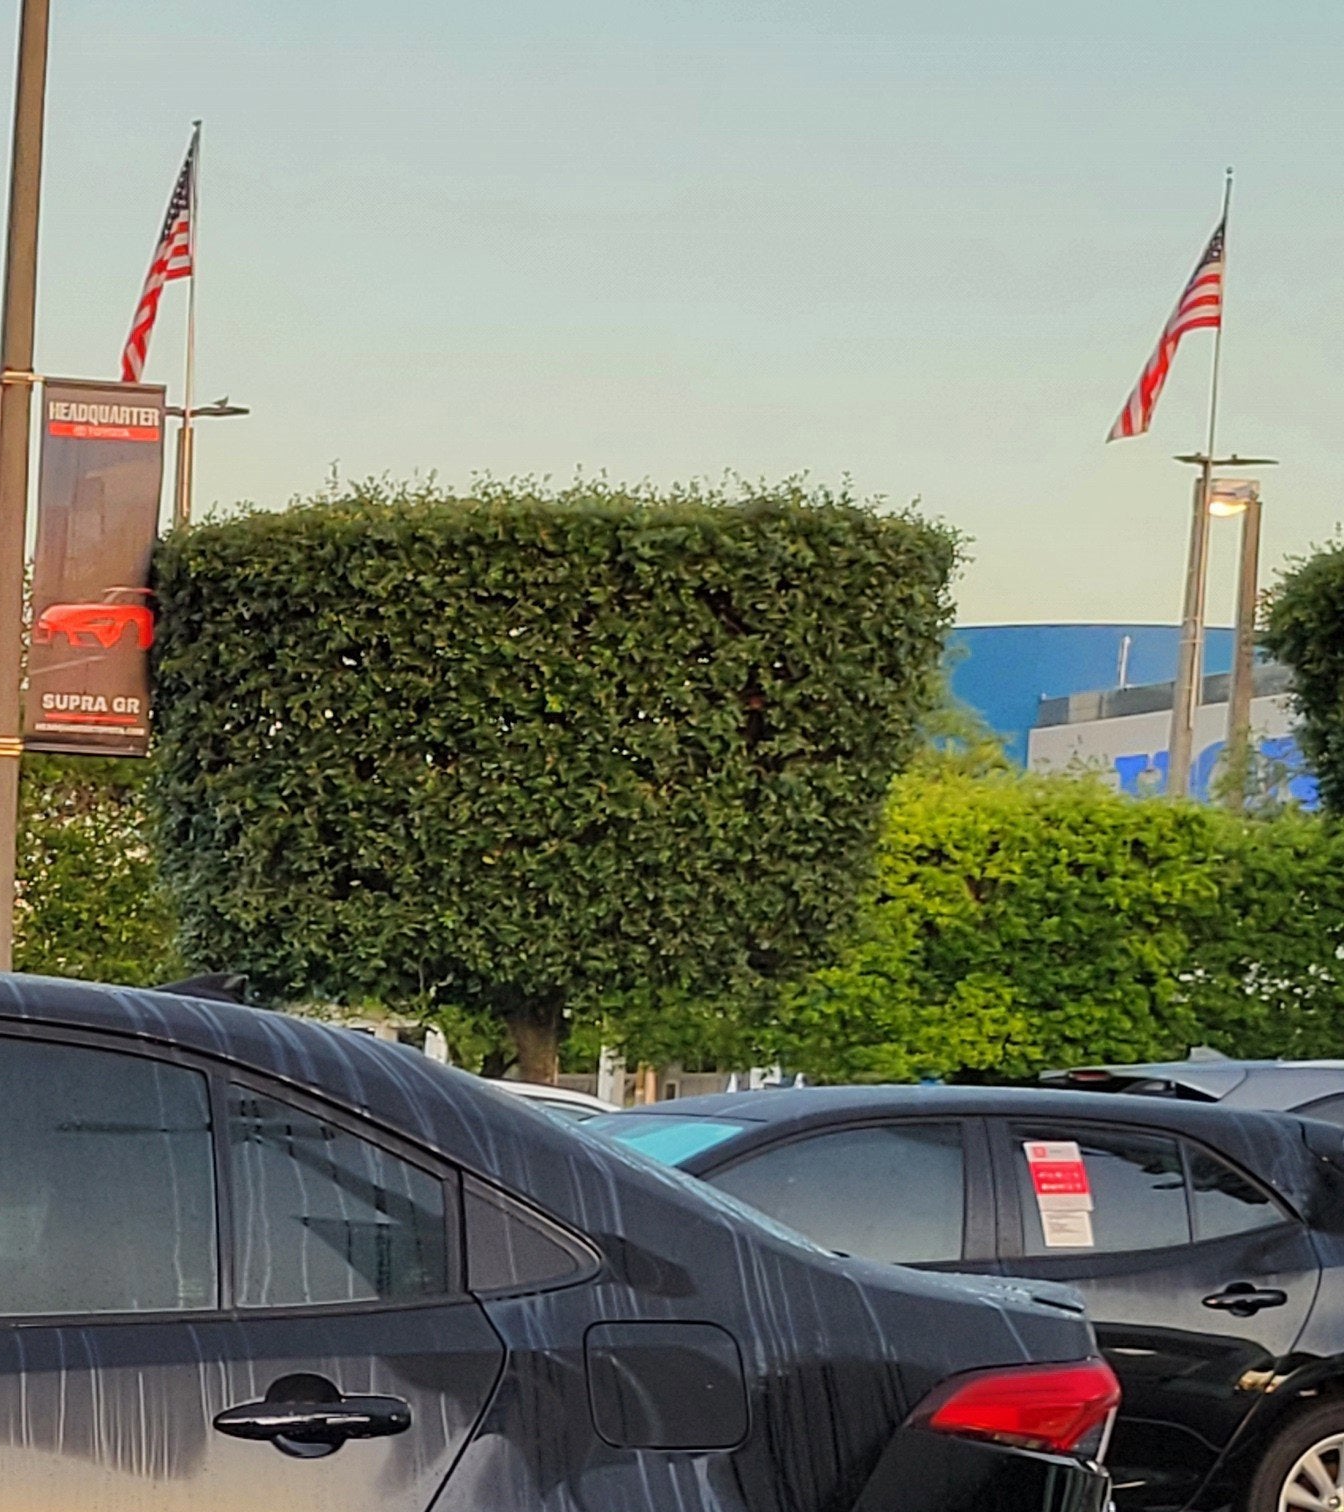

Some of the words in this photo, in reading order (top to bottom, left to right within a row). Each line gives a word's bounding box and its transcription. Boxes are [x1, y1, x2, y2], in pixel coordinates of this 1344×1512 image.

[48, 401, 160, 427] HEADQUARTER
[42, 693, 108, 713] SUPRA
[113, 697, 140, 714] GR
